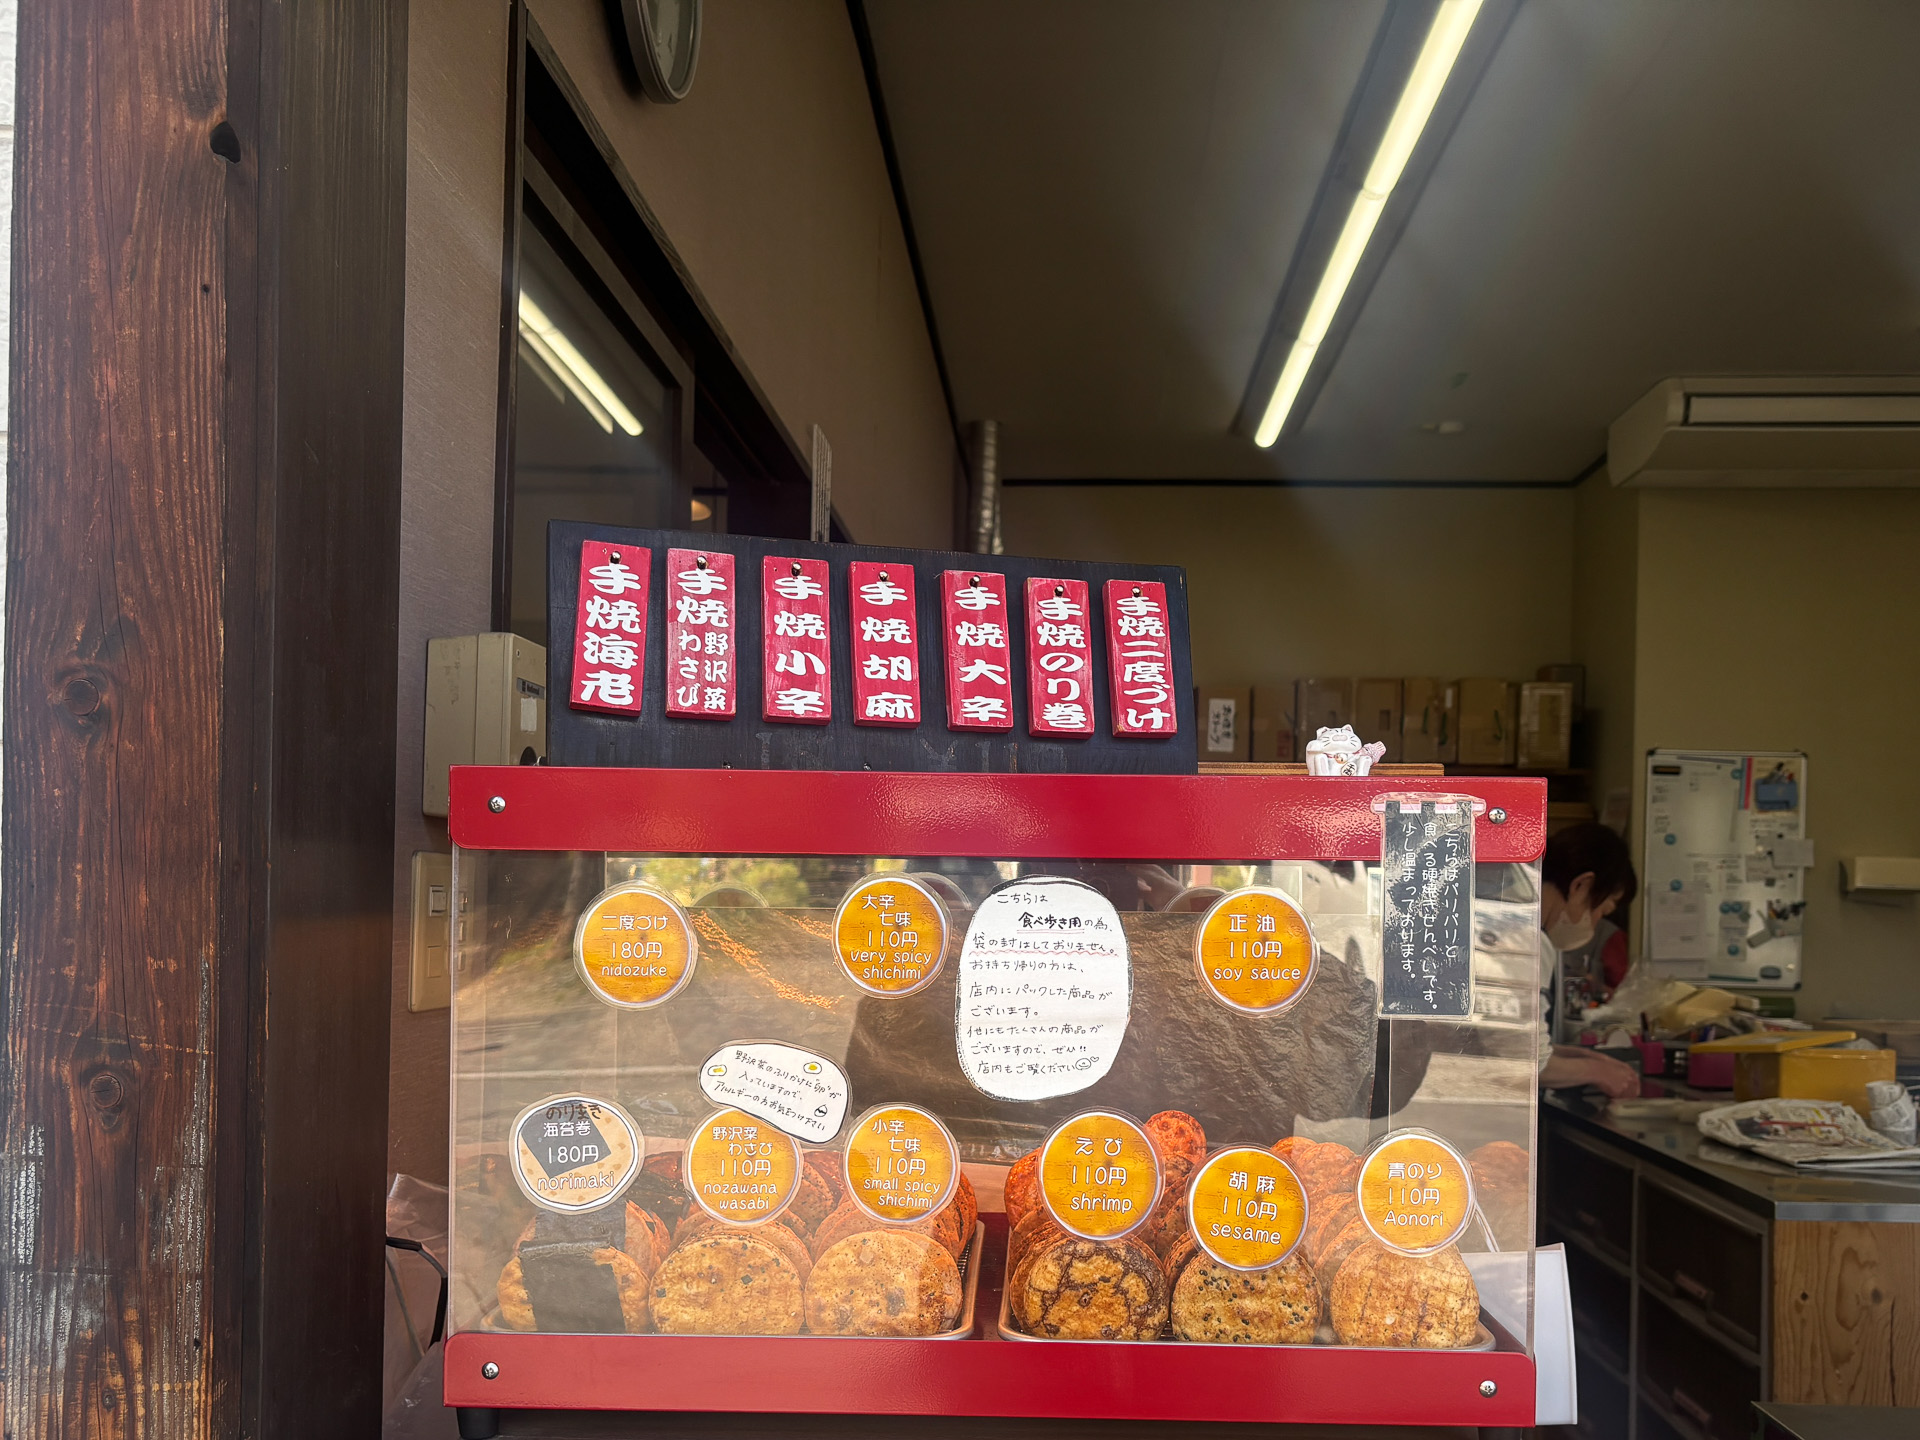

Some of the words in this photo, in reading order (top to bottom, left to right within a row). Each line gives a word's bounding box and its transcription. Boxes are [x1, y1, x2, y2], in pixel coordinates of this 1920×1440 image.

[676, 569, 729, 628] 手焼
[580, 563, 642, 705] 手焼海老
[774, 576, 827, 715] 手焼小辛
[860, 581, 914, 719] 手焼胡麻
[955, 586, 1007, 722] 手焼大辛
[676, 631, 702, 708] わさび
[704, 631, 729, 711] 野沢菜
[1037, 597, 1087, 729] 手焼のり巻
[1116, 596, 1170, 729] 手焼二度づけ
[997, 892, 1048, 904] こちらは
[1444, 823, 1459, 958] こちらはパリパリと
[862, 894, 895, 910] 大辛
[1401, 822, 1417, 979] 少し温まっております。
[602, 914, 669, 931] 二度づけ
[878, 911, 911, 927] 七味
[1229, 914, 1276, 933] 正油
[1422, 822, 1439, 1010] 食べる硬焼きせんべいです。
[868, 930, 918, 948] 110円
[612, 942, 663, 959] 180円
[850, 950, 886, 964] very
[893, 949, 932, 965] spicy
[1229, 941, 1283, 959] 110円
[601, 963, 667, 977] nidozuke
[862, 965, 921, 980] shichimi
[1213, 968, 1243, 981] soy
[1250, 968, 1301, 980] sauce
[969, 981, 1113, 1000] 店内にパックした商品が
[970, 1005, 1039, 1018] ございます。
[546, 1104, 602, 1121] のりまき
[543, 1121, 591, 1137] 海苔巻
[712, 1126, 758, 1141] 野沢菜
[872, 1119, 905, 1135] 小辛
[728, 1142, 773, 1156] わさび
[888, 1136, 921, 1153] 七味
[1075, 1137, 1123, 1156] えび
[548, 1145, 599, 1164] 180円
[720, 1159, 772, 1176] 110円
[876, 1156, 926, 1176] 110円
[1388, 1162, 1442, 1180] 青のり
[537, 1171, 614, 1191] norimaki
[1072, 1165, 1127, 1186] 110円
[1228, 1170, 1276, 1194] 胡麻
[703, 1183, 778, 1194] nozawana
[863, 1177, 899, 1190] small
[904, 1179, 941, 1195] spicy
[719, 1196, 769, 1210] wasabi
[878, 1193, 933, 1208] shichimi
[1070, 1193, 1133, 1214] shrimp
[1389, 1187, 1440, 1205] 110円
[1223, 1196, 1278, 1221] 110円
[1384, 1210, 1444, 1226] Aonori
[1210, 1223, 1281, 1244] sesame
